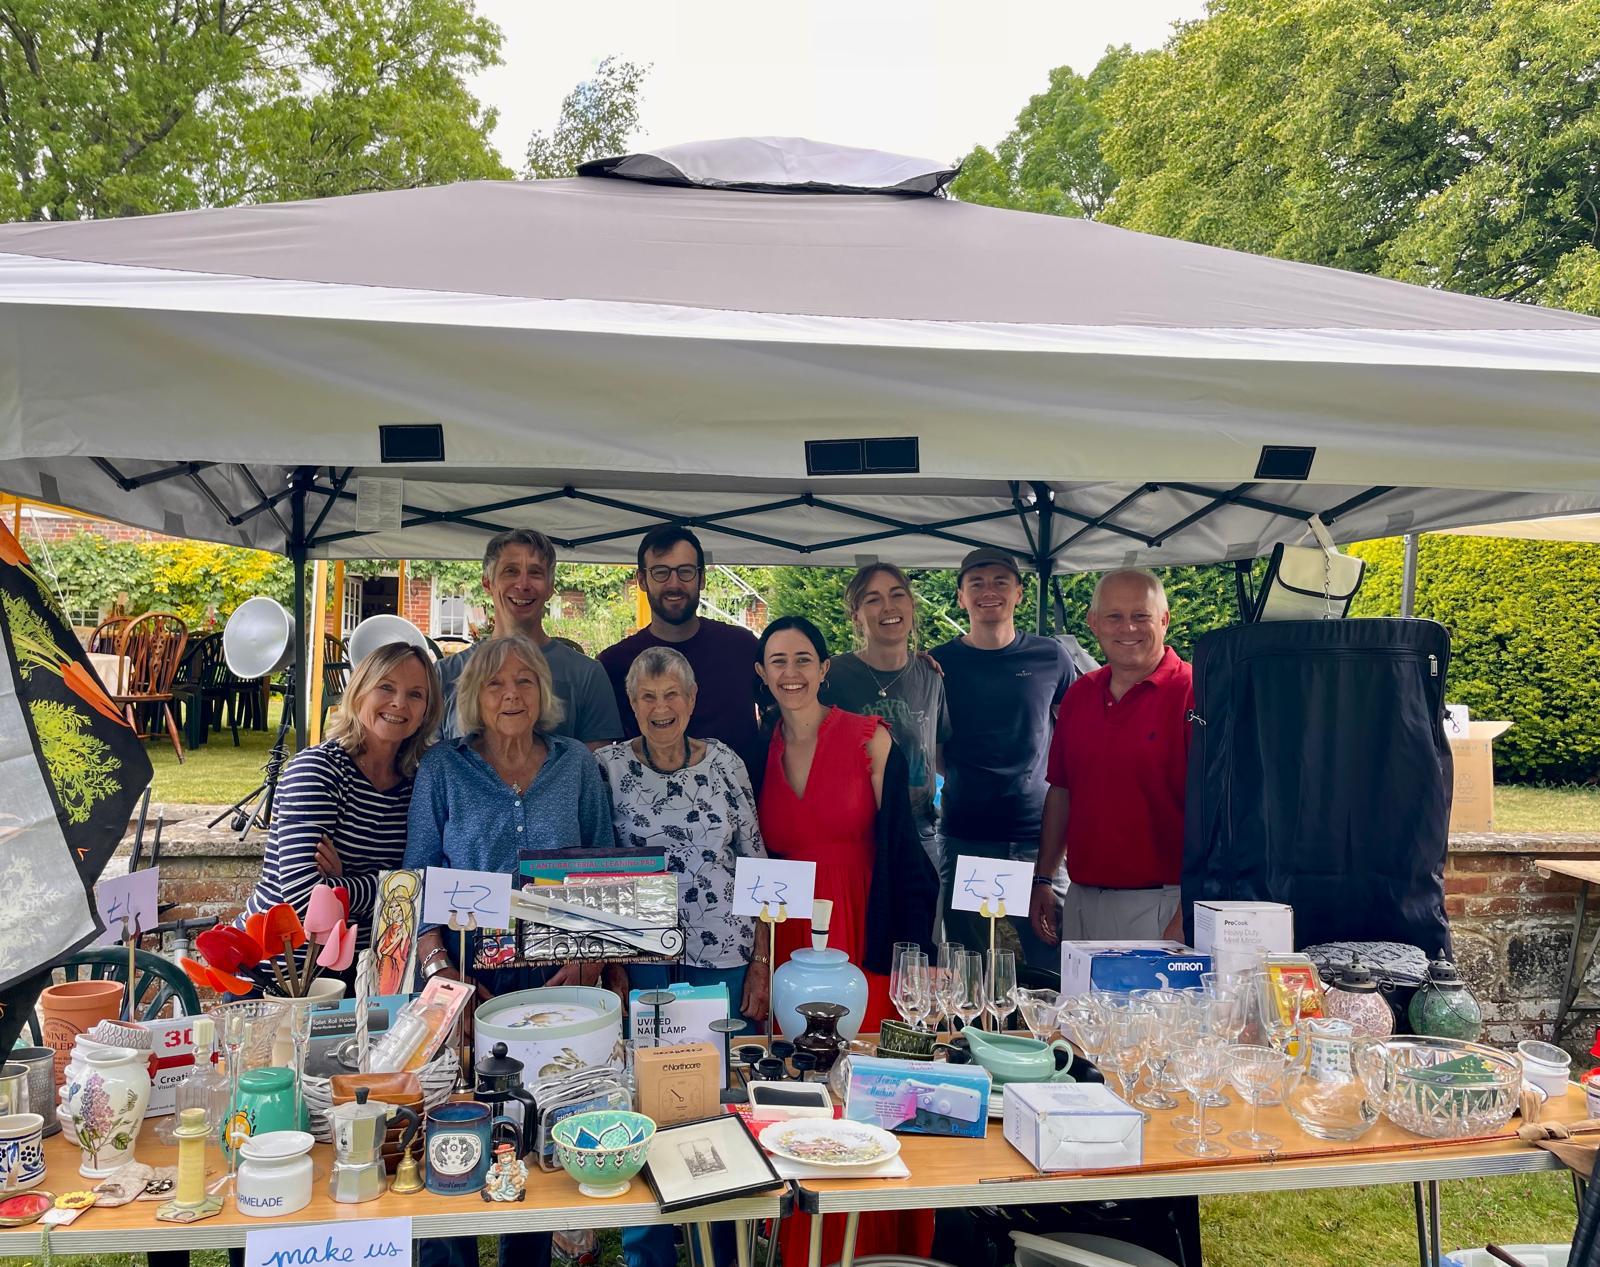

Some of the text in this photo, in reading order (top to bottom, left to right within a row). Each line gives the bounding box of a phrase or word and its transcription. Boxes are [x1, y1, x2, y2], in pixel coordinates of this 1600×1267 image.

[963, 868, 1015, 899] £5
[746, 875, 788, 904] £3
[443, 880, 499, 914] £2
[1223, 929, 1259, 938] Heavy Duty
[1167, 962, 1203, 971] OMRON
[637, 1018, 671, 1027] UV/ED
[637, 1026, 687, 1035] NAI LAMP
[669, 1062, 701, 1071] Northcore
[160, 1072, 189, 1084] Creati
[262, 1235, 403, 1267] make us
